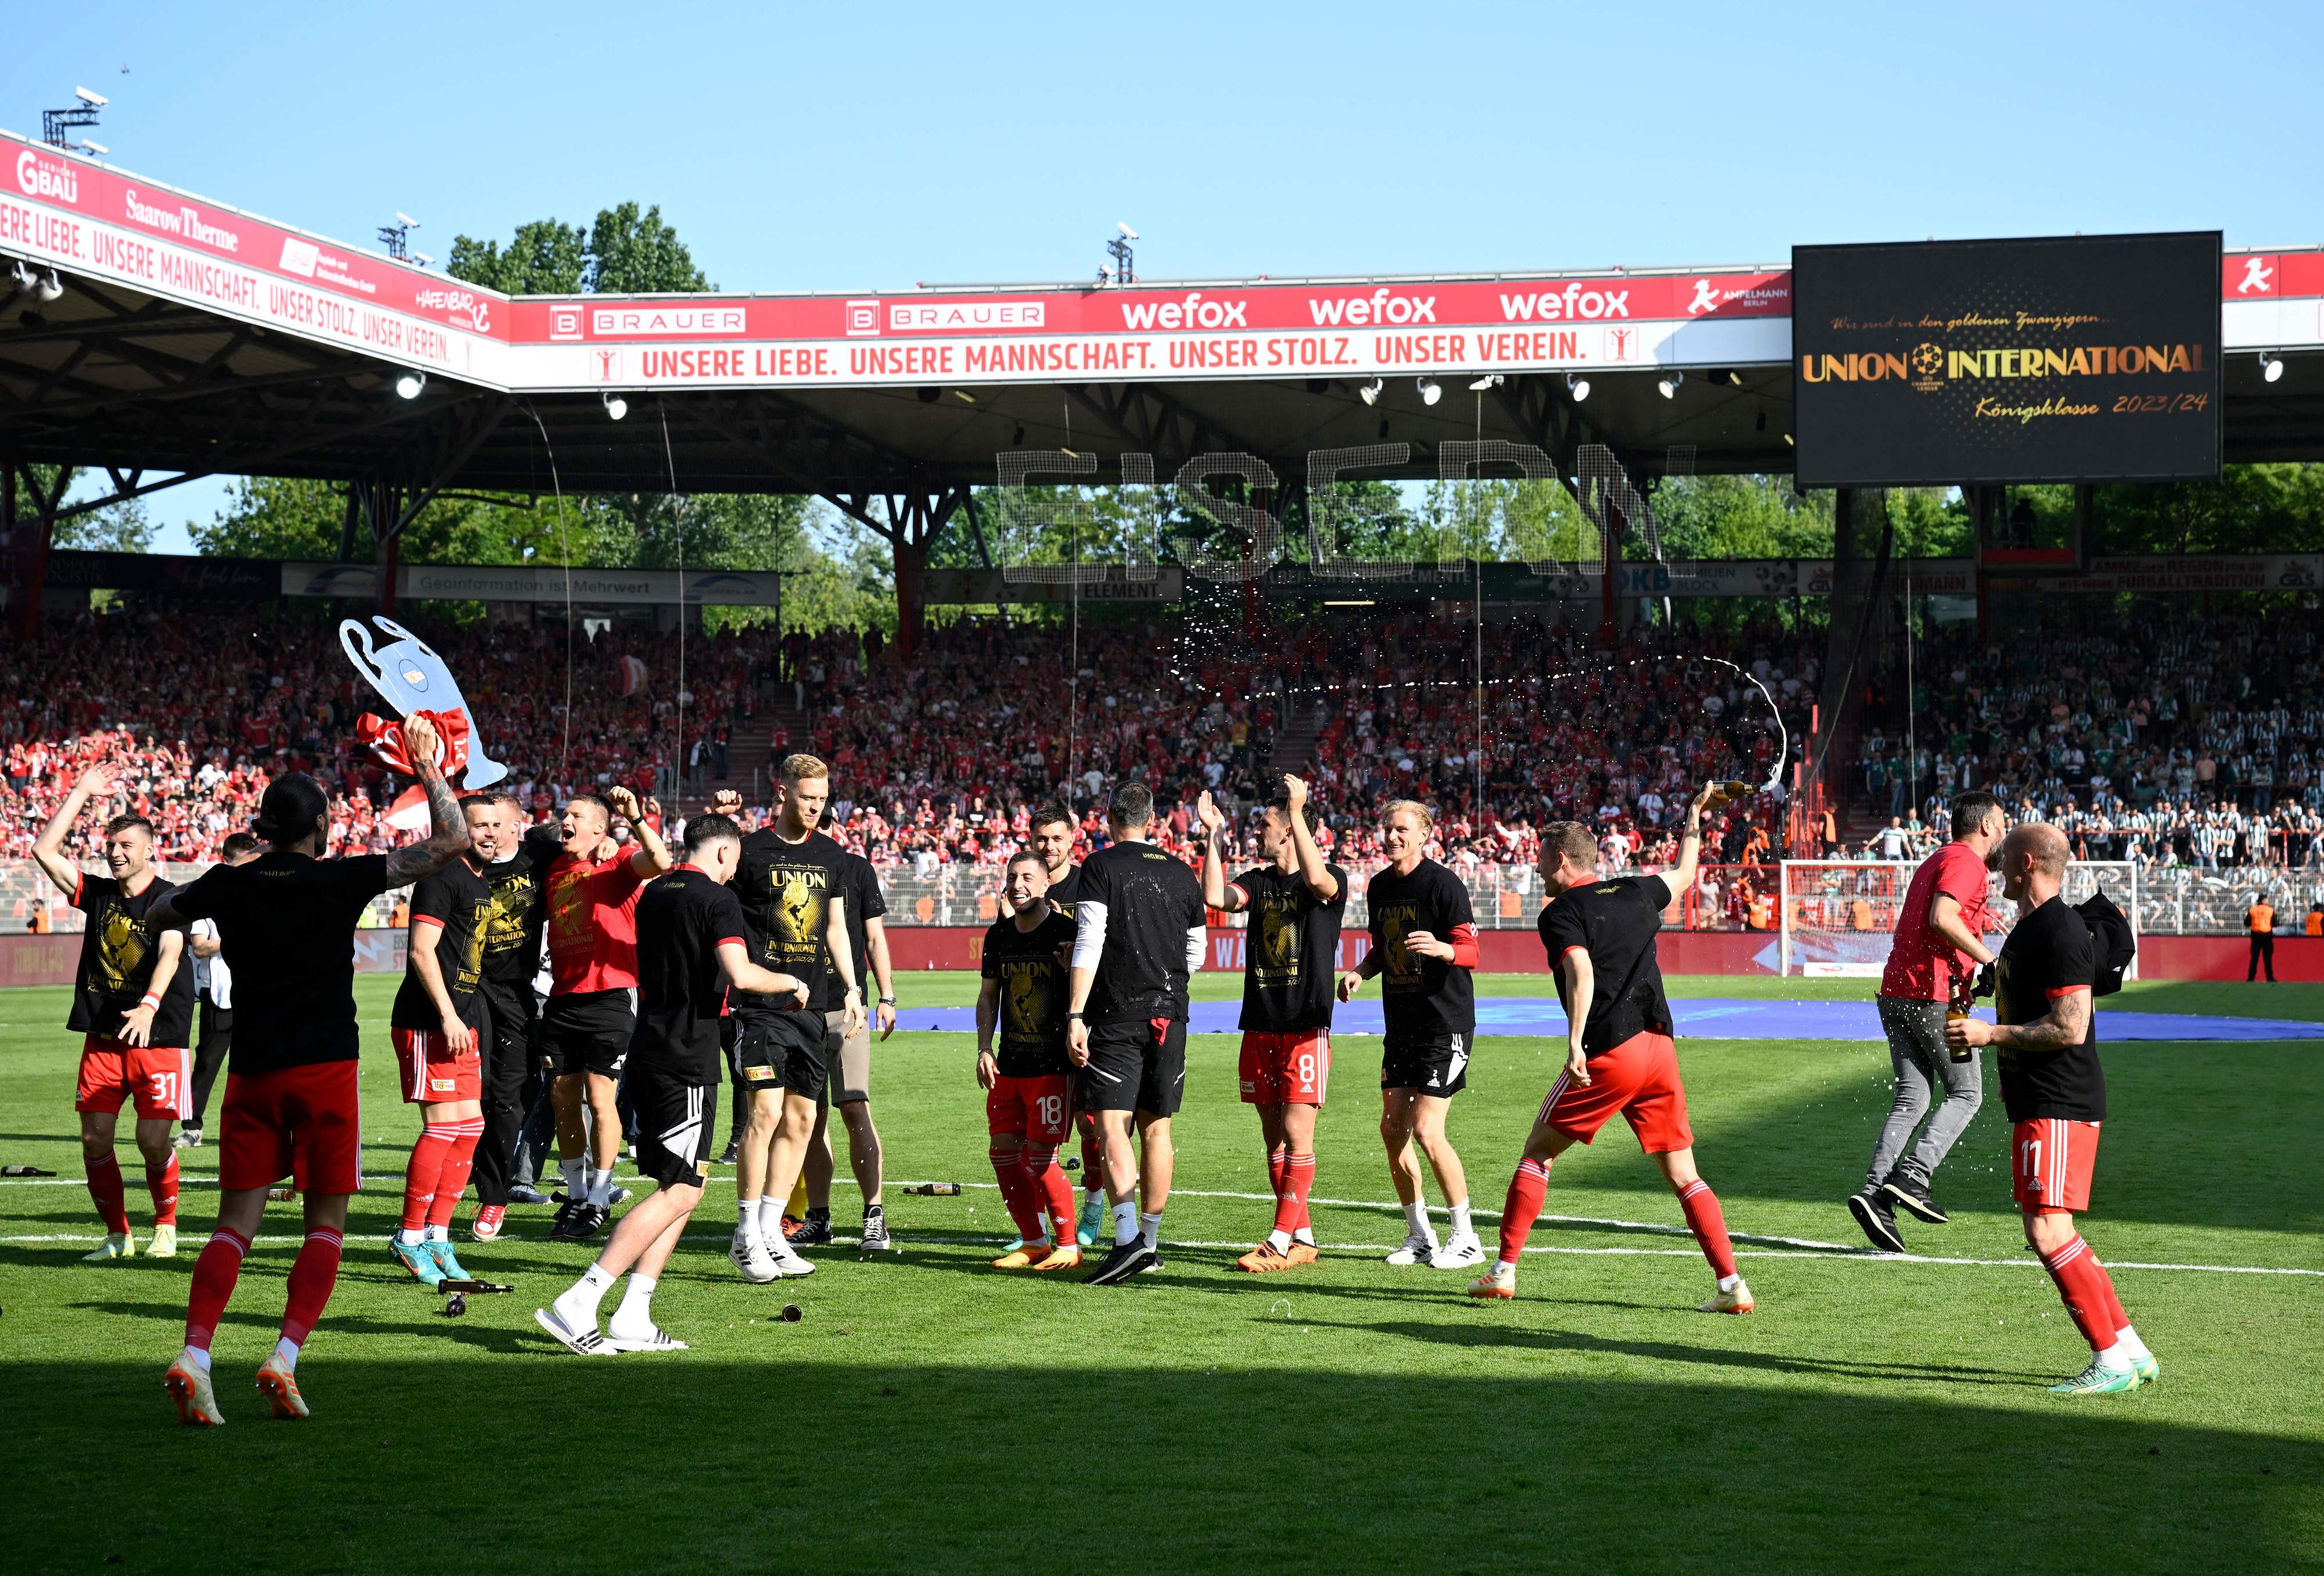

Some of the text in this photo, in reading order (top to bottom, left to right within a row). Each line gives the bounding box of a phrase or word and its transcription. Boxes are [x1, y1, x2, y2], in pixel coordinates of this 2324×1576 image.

[125, 189, 238, 252] SaarowTherme
[0, 203, 30, 244] ERE
[35, 213, 85, 260] LIEBE.
[94, 231, 154, 279] UNSERE
[160, 252, 260, 310] MANNSCHAFT.
[270, 284, 313, 324] UNSER
[318, 299, 358, 338] STOLZ.
[364, 311, 401, 349] UNSER
[406, 325, 450, 363] VEREIN.
[415, 289, 474, 314] HAFENBAR
[1500, 282, 1629, 320] wefox
[1723, 288, 1788, 300] AMPELMANN
[1743, 299, 1768, 307] BERLIN
[894, 307, 1041, 325] BRAUER
[1121, 292, 1247, 329] wefox
[1308, 288, 1436, 325] wefox
[597, 313, 741, 330] BRAUER
[1831, 317, 1858, 329] Wir
[1862, 315, 1894, 329] sind
[1898, 317, 1914, 328] in
[1918, 314, 1944, 328] den
[1947, 312, 2011, 332] goldenen
[642, 331, 1586, 378] UNSERE LIEBE. UNSERE MANNSCHAFT. UNSER STOLZ. UNSER VEREIN.
[1803, 344, 2210, 383] UNION INTERNATIONAL
[1974, 392, 2207, 425] Königsklasse 2023/24
[49, 557, 107, 570] NSPORT
[45, 570, 105, 584] OGISTIK
[420, 576, 650, 595] Geoinformation ist Mehrwert
[1676, 580, 1720, 591] BLOCK
[1084, 583, 1159, 598] ELEMENT
[772, 870, 826, 889] UNION
[1377, 906, 1416, 921] UNION
[768, 939, 817, 954] INTERNATIONAL
[1215, 931, 1246, 968] WÄ
[1001, 961, 1051, 978] UNION
[1255, 966, 1299, 978] NTERNATIONAL
[1008, 1031, 1053, 1044] INTERNATIONAL
[1299, 1053, 1315, 1083] 8
[1433, 1069, 1437, 1078] 2
[151, 1072, 177, 1100] 31
[1036, 1094, 1062, 1125] 18
[2021, 1139, 2042, 1177] 11
[1278, 1193, 1299, 1204] adidas
[569, 1341, 589, 1355] adidas
